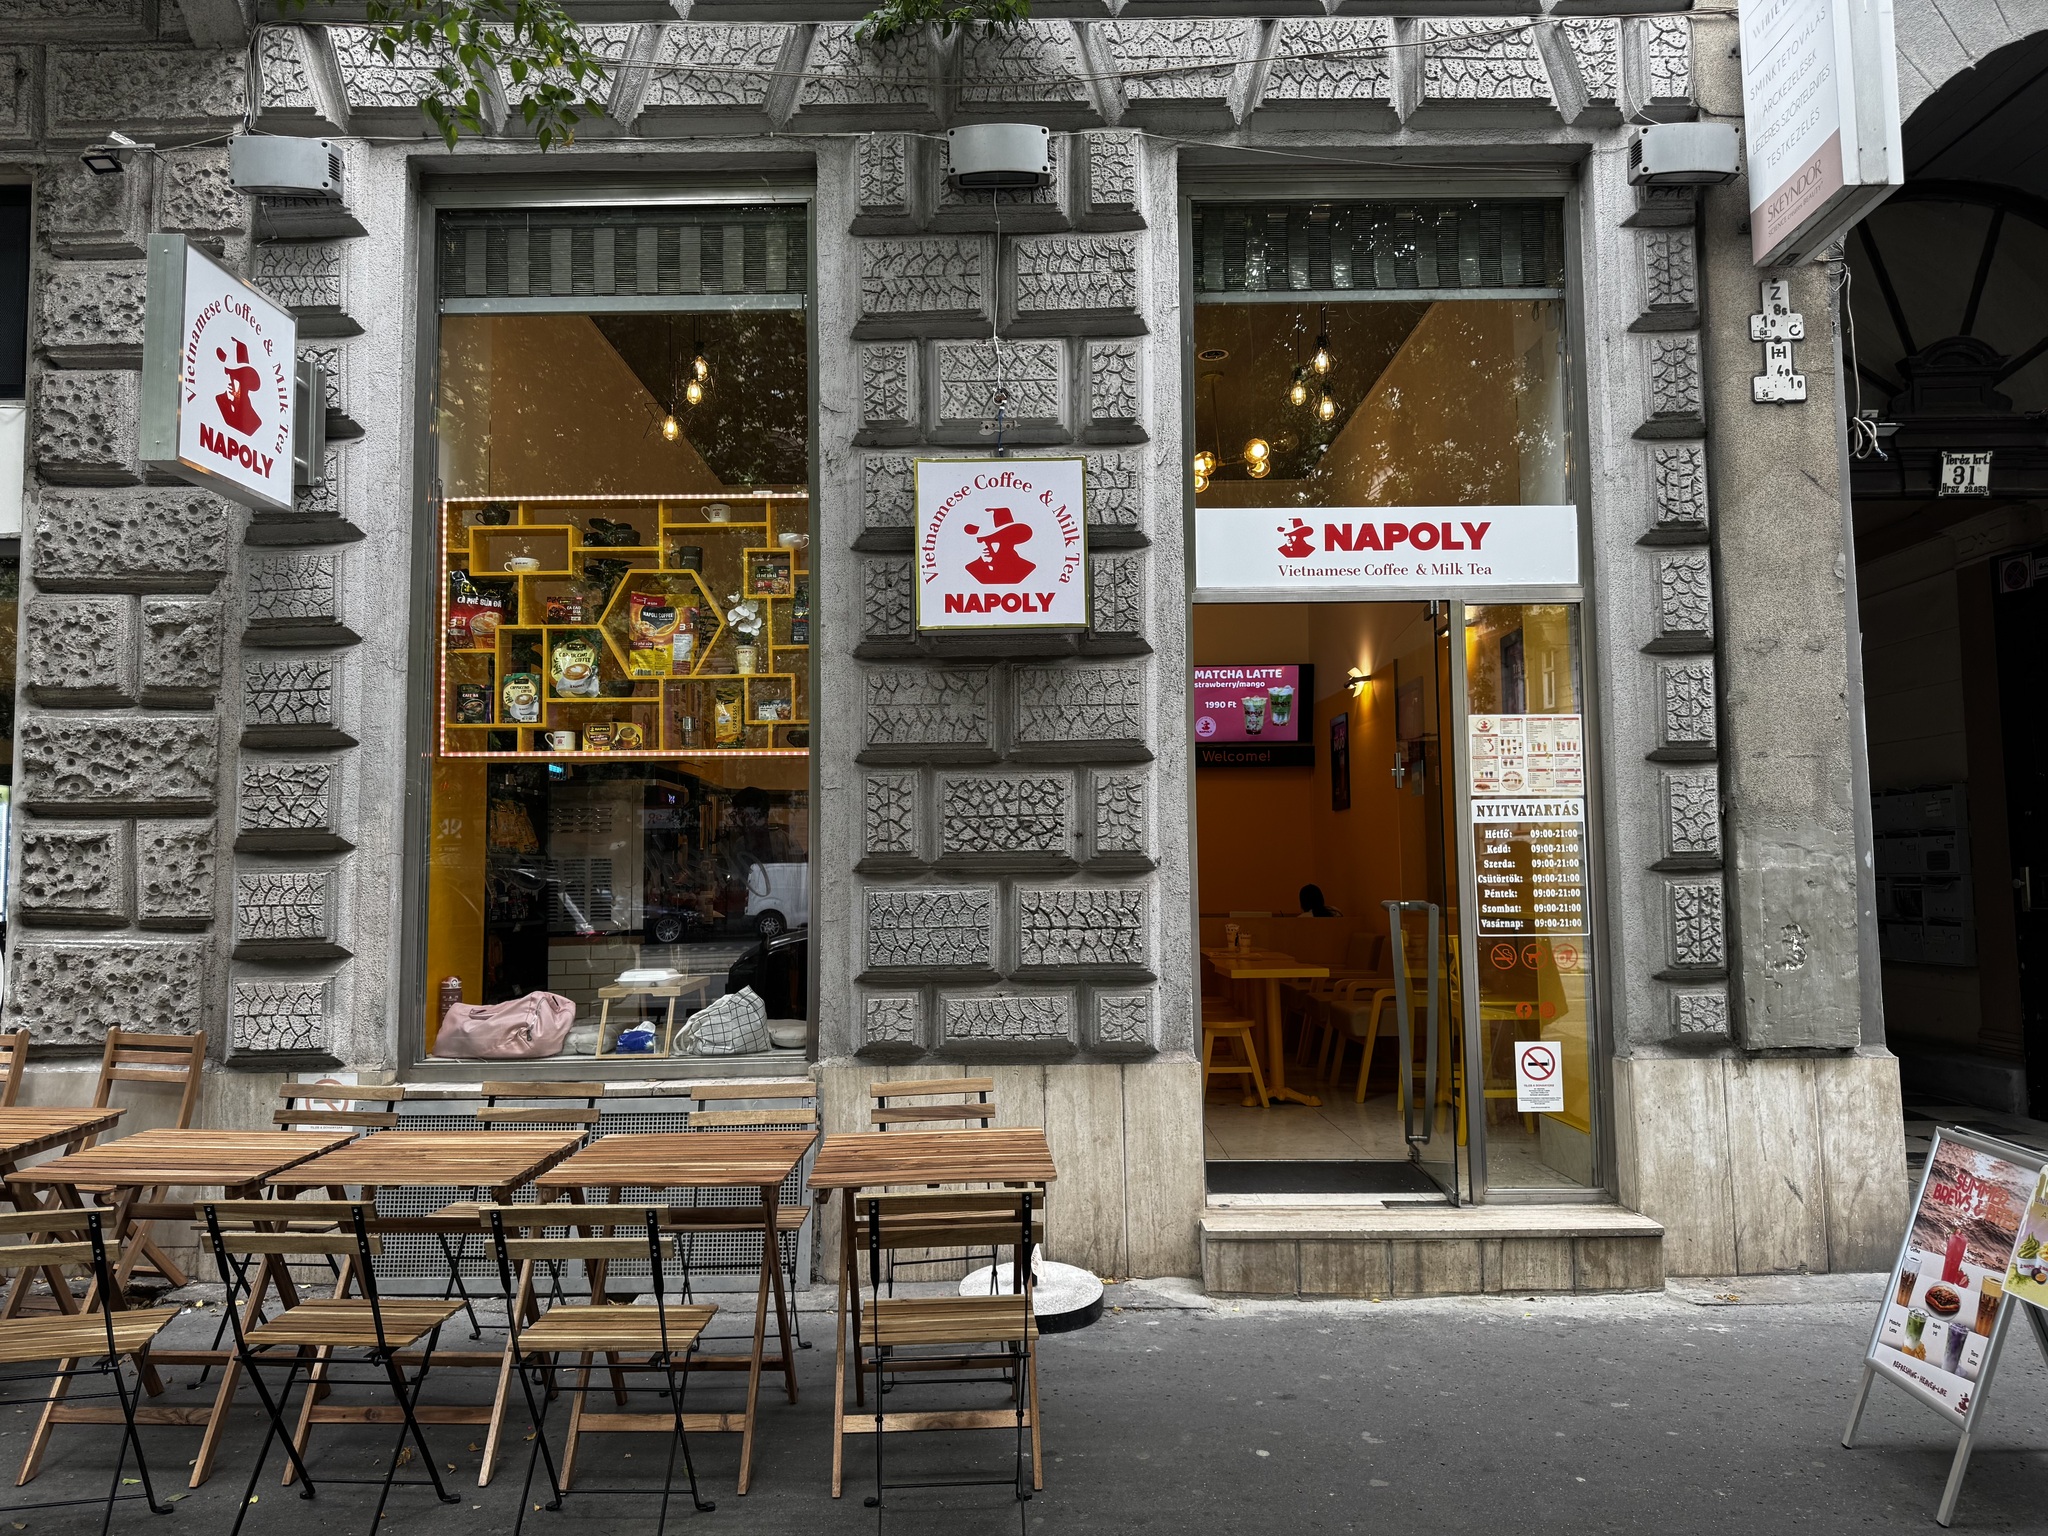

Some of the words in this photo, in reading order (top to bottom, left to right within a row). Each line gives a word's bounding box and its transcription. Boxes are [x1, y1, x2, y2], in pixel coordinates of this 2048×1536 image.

[1766, 106, 1820, 169] TESTKEZELÉS
[1768, 159, 1822, 223] SKEYNDOR
[1770, 286, 1781, 301] Z
[224, 294, 262, 336] Coffee
[185, 300, 222, 404] Vietnamese
[263, 338, 274, 357] &
[272, 361, 289, 415] Milk
[275, 423, 289, 454] Tea
[199, 422, 274, 479] NAPOLY
[1945, 454, 1970, 465] Teréz
[974, 472, 1032, 493] Coffee
[1953, 465, 1975, 485] 31
[1942, 482, 1960, 493] Hrsz
[1039, 489, 1054, 507] &
[922, 485, 972, 584] Vietnamese
[1052, 504, 1080, 548] Milk
[1324, 522, 1492, 551] NAPOLY
[1059, 552, 1080, 584] Tea
[1278, 564, 1361, 577] Vietnamese
[1364, 563, 1409, 576] Coffee
[1416, 563, 1427, 575] &
[1431, 563, 1464, 575] Milk
[1467, 563, 1492, 575] Tea
[945, 593, 1056, 613] NAPOLY
[1194, 669, 1243, 679] MATCHA
[1246, 669, 1283, 678] LATTE
[1202, 750, 1271, 762] Welcome!
[1477, 800, 1579, 817] NYITVATARTÁS
[1485, 829, 1513, 839] Hétfő:
[1530, 829, 1578, 838] 09:00-21:00
[1487, 845, 1511, 853] Kedd:
[1531, 844, 1578, 853] 09:00-21:00
[1484, 859, 1516, 868] Szerda:
[1531, 859, 1579, 868] 09:00-21:00
[1478, 873, 1523, 883] Csütörtök:
[1532, 873, 1580, 883] 09:00-21:00
[1484, 889, 1518, 898] Péntek:
[1533, 888, 1581, 898] 09:00-21:00
[1482, 904, 1521, 913] Szombat:
[1534, 903, 1581, 913] 09:00-21:00
[1481, 919, 1523, 930] Vasárnap:
[1534, 919, 1582, 928] 09:00-21:00
[1933, 1183, 1972, 1212] BREWS
[1955, 1173, 2009, 1208] SUMMER
[1893, 1360, 1917, 1379] REFRESHING
